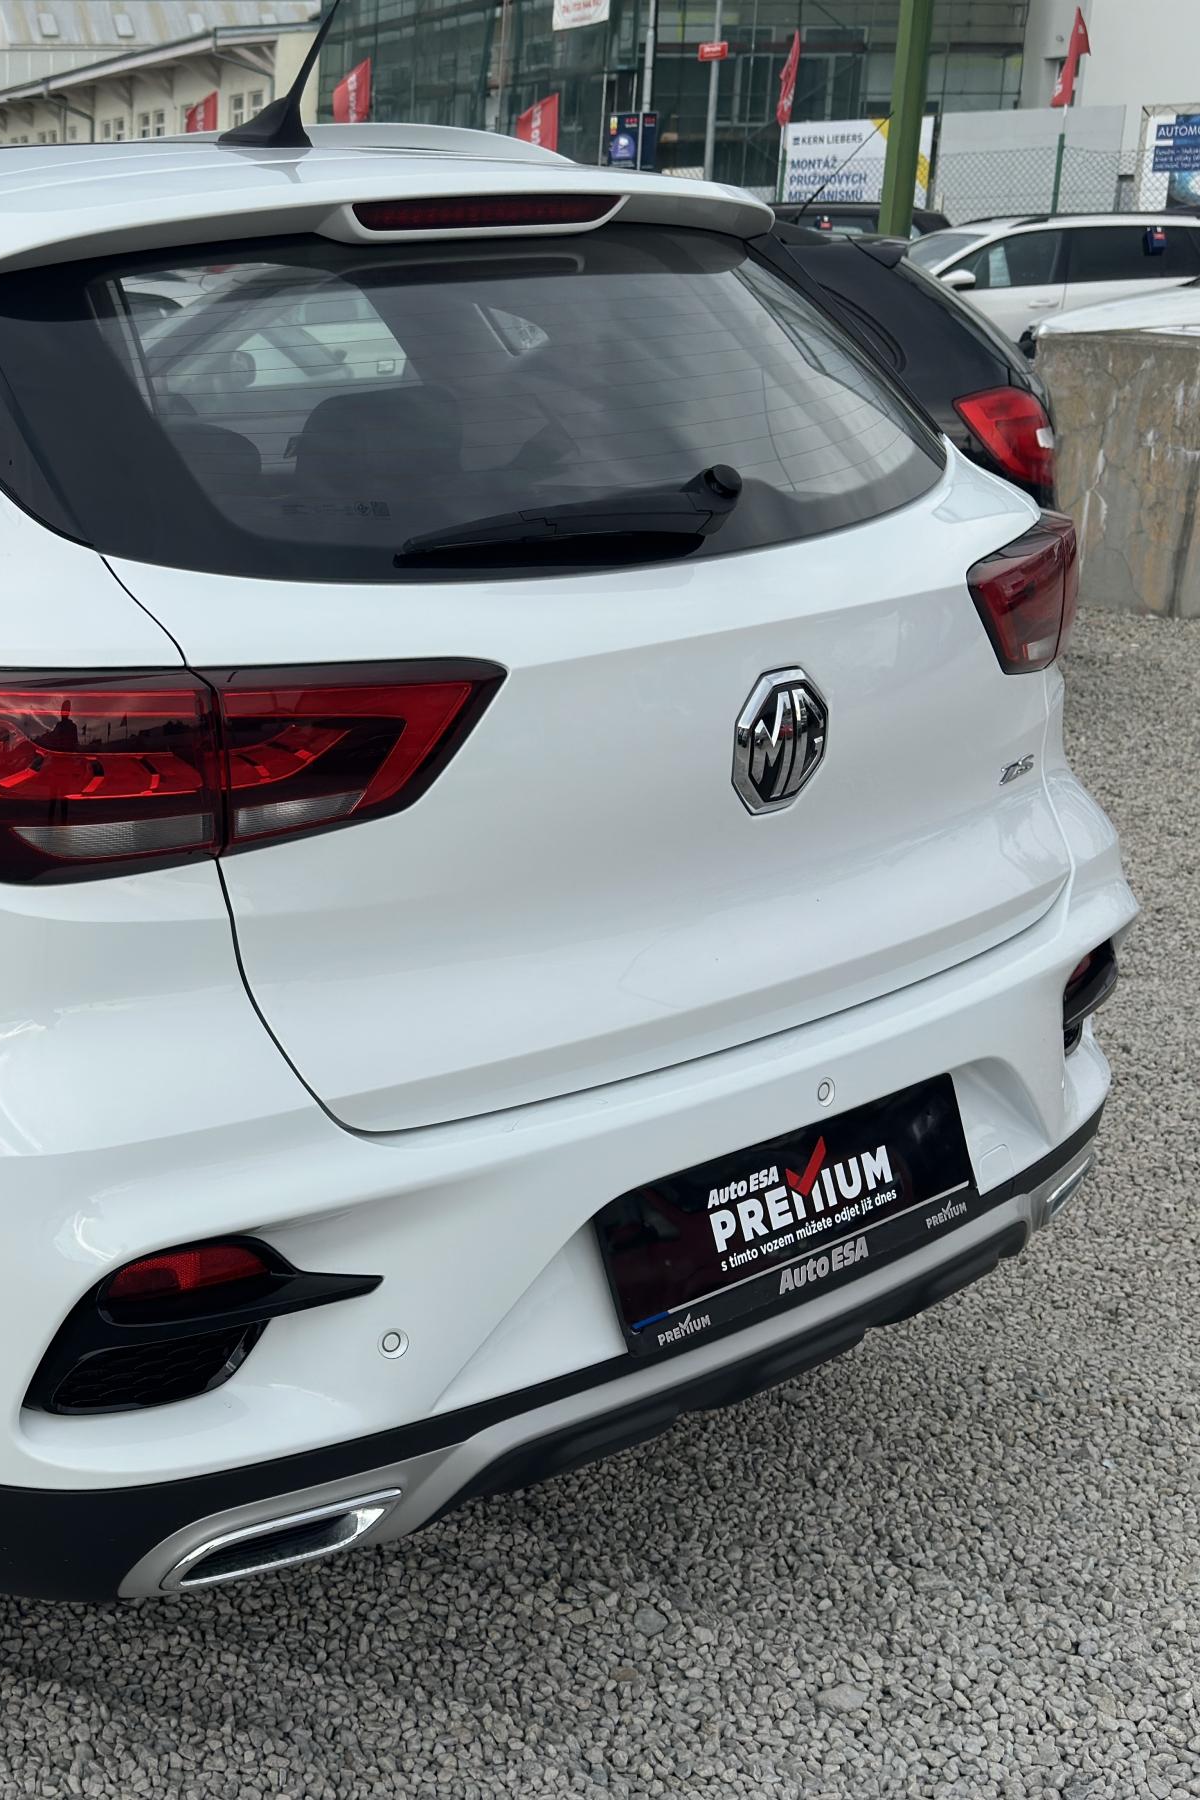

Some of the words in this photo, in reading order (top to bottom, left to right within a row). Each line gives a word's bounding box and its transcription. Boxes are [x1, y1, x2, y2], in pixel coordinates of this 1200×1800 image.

[801, 135, 825, 145] KERN
[826, 133, 863, 144] LIEBERS
[791, 155, 837, 169] MONTÁŽ
[707, 1179, 748, 1209] Auto
[749, 1165, 780, 1193] ESA
[709, 1143, 894, 1253] PREMIUM
[720, 1261, 728, 1272] s
[729, 1247, 759, 1268] tímto
[760, 1234, 795, 1255] vozem
[796, 1217, 833, 1241] můžete
[834, 1205, 861, 1226] odjet
[861, 1198, 874, 1216] již
[874, 1189, 897, 1206] dnes
[925, 1200, 967, 1229] PREMIUM
[779, 1255, 830, 1295] Auto
[831, 1236, 869, 1272] ESA
[657, 1313, 711, 1346] PREMIUM
